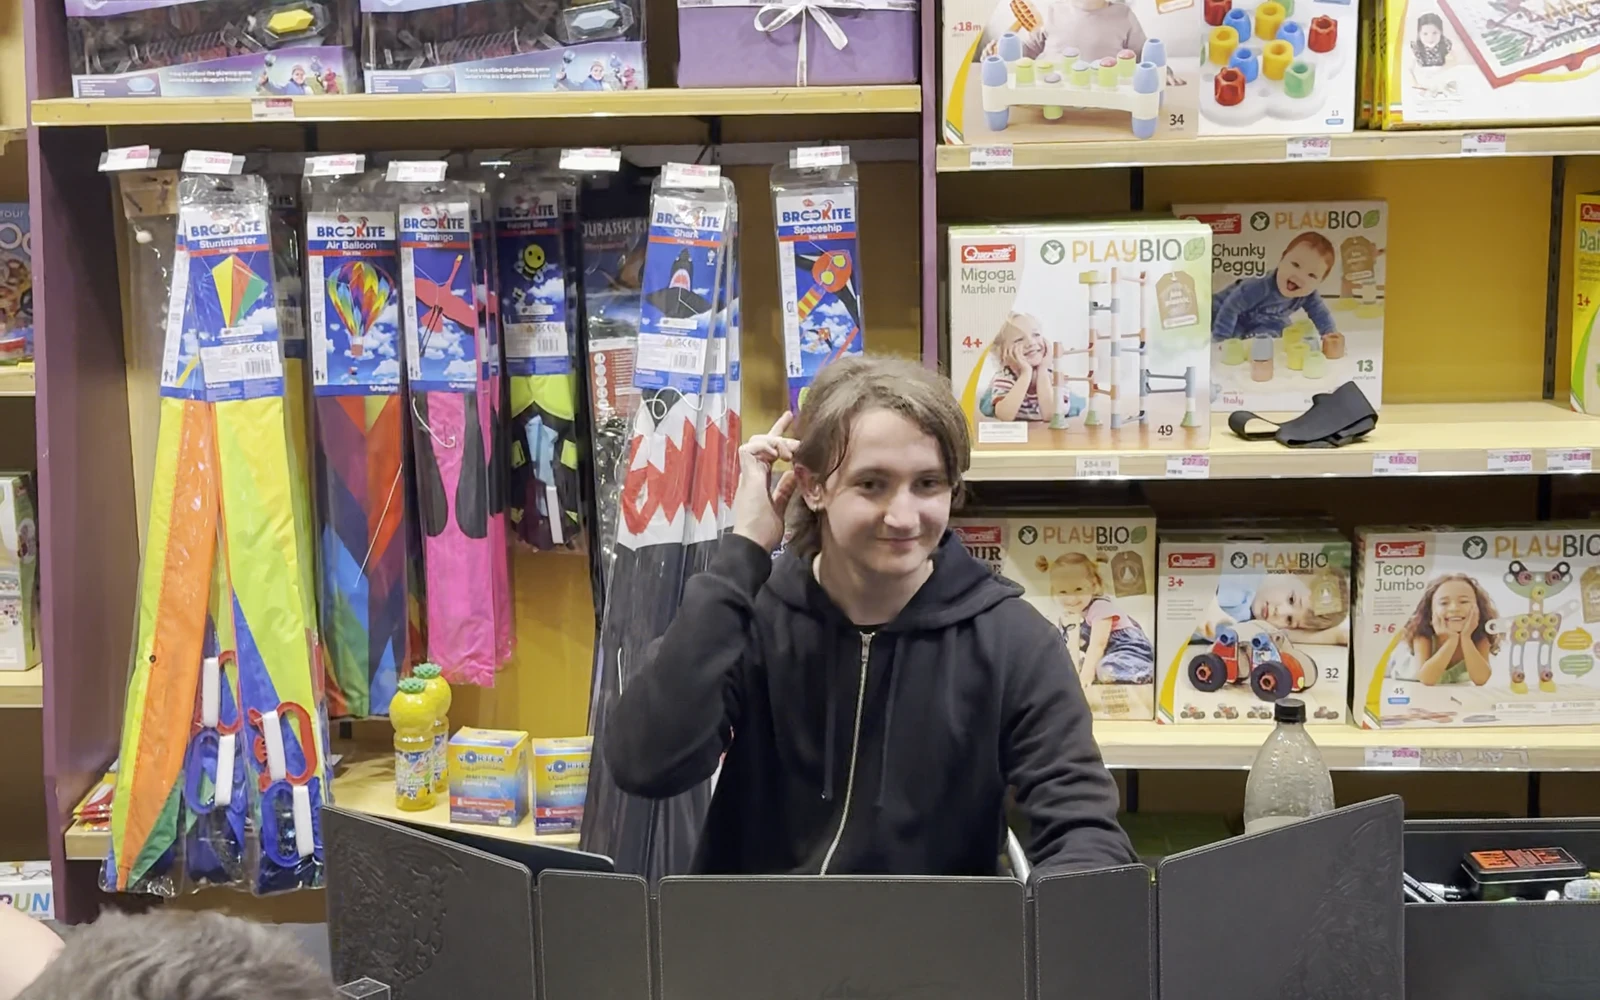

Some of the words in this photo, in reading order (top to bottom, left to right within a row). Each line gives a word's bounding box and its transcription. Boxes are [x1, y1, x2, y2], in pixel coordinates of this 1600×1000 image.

[1170, 114, 1184, 126] 34
[783, 205, 852, 222] BROOKITE
[1274, 210, 1362, 230] PLAYBIO
[404, 214, 464, 230] BROOKITE
[317, 222, 386, 238] BROOKITE
[582, 222, 632, 238] JURASSIC
[674, 228, 699, 239] Shark
[794, 223, 842, 235] Spaceship
[200, 237, 258, 249] Stuntmaster
[416, 232, 454, 242] Flamingo
[326, 240, 340, 250] Air
[342, 240, 376, 250] Balloon
[1072, 238, 1182, 263] PLAYBIO
[1212, 243, 1266, 258] Chunky
[1212, 258, 1266, 276] Peggy
[961, 268, 1016, 284] Migoga
[961, 284, 996, 294] Marble
[999, 285, 1016, 294] run
[1577, 293, 1591, 306] 1+
[962, 336, 983, 348] 4+
[1356, 360, 1374, 372] 13
[1223, 396, 1244, 406] Italy
[1158, 424, 1173, 436] 49
[1044, 526, 1130, 544] PLAYBIO
[968, 546, 1002, 560] OUR
[1252, 552, 1328, 568] PLAYBIO
[1375, 561, 1425, 576] Tecno
[1168, 576, 1184, 587] 3+
[1374, 577, 1424, 592] Jumbo
[1325, 668, 1339, 678] 32
